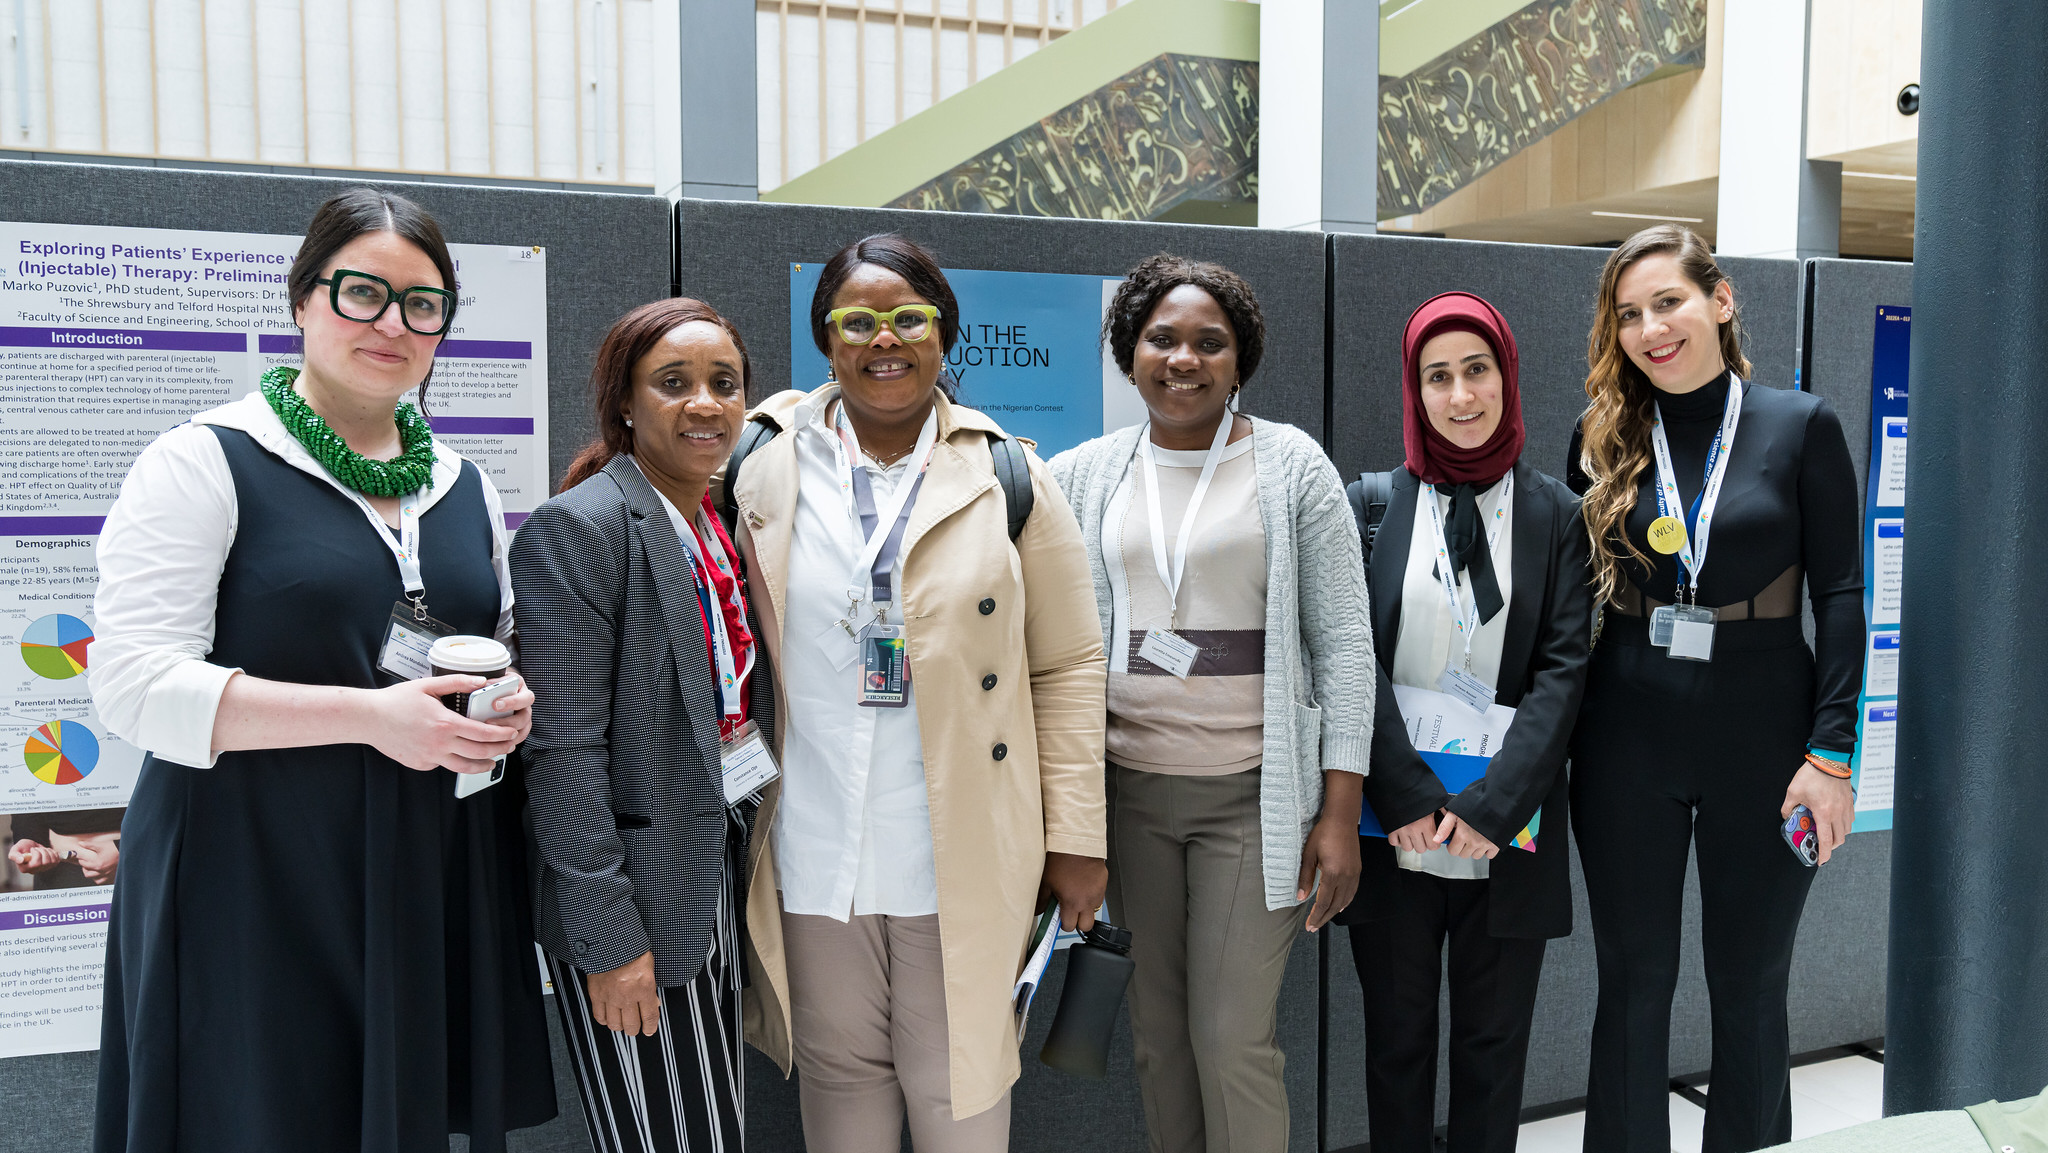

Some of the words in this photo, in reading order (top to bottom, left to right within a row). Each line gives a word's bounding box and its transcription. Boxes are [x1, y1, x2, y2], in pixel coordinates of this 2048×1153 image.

[19, 240, 105, 259] Exploring
[191, 248, 285, 264] Experience
[520, 250, 532, 259] 18
[18, 260, 116, 278] (Injectable)
[121, 264, 198, 282] Therapy:
[2, 280, 43, 291] Marko
[105, 283, 130, 294] PhD
[133, 285, 183, 297] student,
[187, 287, 258, 299] Supervisors:
[262, 289, 276, 299] Dr
[86, 298, 151, 311] Shrewsbury
[154, 301, 174, 310] and
[176, 301, 213, 311] Telford
[216, 303, 259, 314] Hospital
[262, 305, 284, 314] NHS
[64, 312, 76, 322] of
[78, 313, 120, 323] Science
[122, 315, 143, 324] and
[146, 315, 213, 328] Engineering,
[215, 317, 250, 327] School
[253, 318, 264, 328] of
[51, 332, 142, 344] Introduction
[977, 324, 1027, 345] THE
[59, 352, 104, 361] discharged
[170, 355, 216, 363] (injectable)
[75, 363, 88, 371] for
[96, 364, 134, 372] specified
[135, 365, 162, 373] period
[50, 374, 83, 382] therapy
[84, 374, 107, 383] (HPT)
[166, 376, 212, 385] complexity,
[213, 376, 233, 384] from
[460, 381, 490, 389] develop
[57, 395, 74, 403] that
[161, 398, 201, 406] managing
[433, 391, 460, 399] suggest
[461, 391, 497, 399] strategies
[438, 400, 451, 408] UK.
[1002, 404, 1033, 413] Nigerian
[1033, 404, 1063, 412] Contest
[48, 438, 89, 447] delegated
[19, 460, 59, 469] discharge
[93, 460, 114, 468] Early
[9, 481, 26, 489] HPT
[28, 481, 52, 489] effect
[67, 481, 97, 490] Quality
[98, 481, 108, 489] of
[5, 492, 31, 500] States
[33, 492, 42, 500] of
[43, 492, 81, 500] America,
[1653, 522, 1674, 538] WLV
[15, 538, 91, 549] Demographics
[20, 566, 50, 575] (n=19),
[14, 698, 55, 706] Parenteral
[1429, 714, 1443, 750] FESTIVAL
[1479, 734, 1489, 757] PROGR
[68, 889, 102, 897] parenteral
[23, 909, 107, 924] Discussion
[14, 934, 55, 945] described
[56, 933, 87, 941] various
[22, 945, 67, 954] identifying
[68, 941, 98, 950] several
[23, 966, 64, 976] highlights
[1, 979, 17, 987] HPT
[29, 977, 52, 985] order
[65, 972, 97, 982] identify
[11, 986, 67, 997] development
[68, 984, 84, 992] and
[63, 1004, 83, 1013] used
[23, 1019, 37, 1027] the
